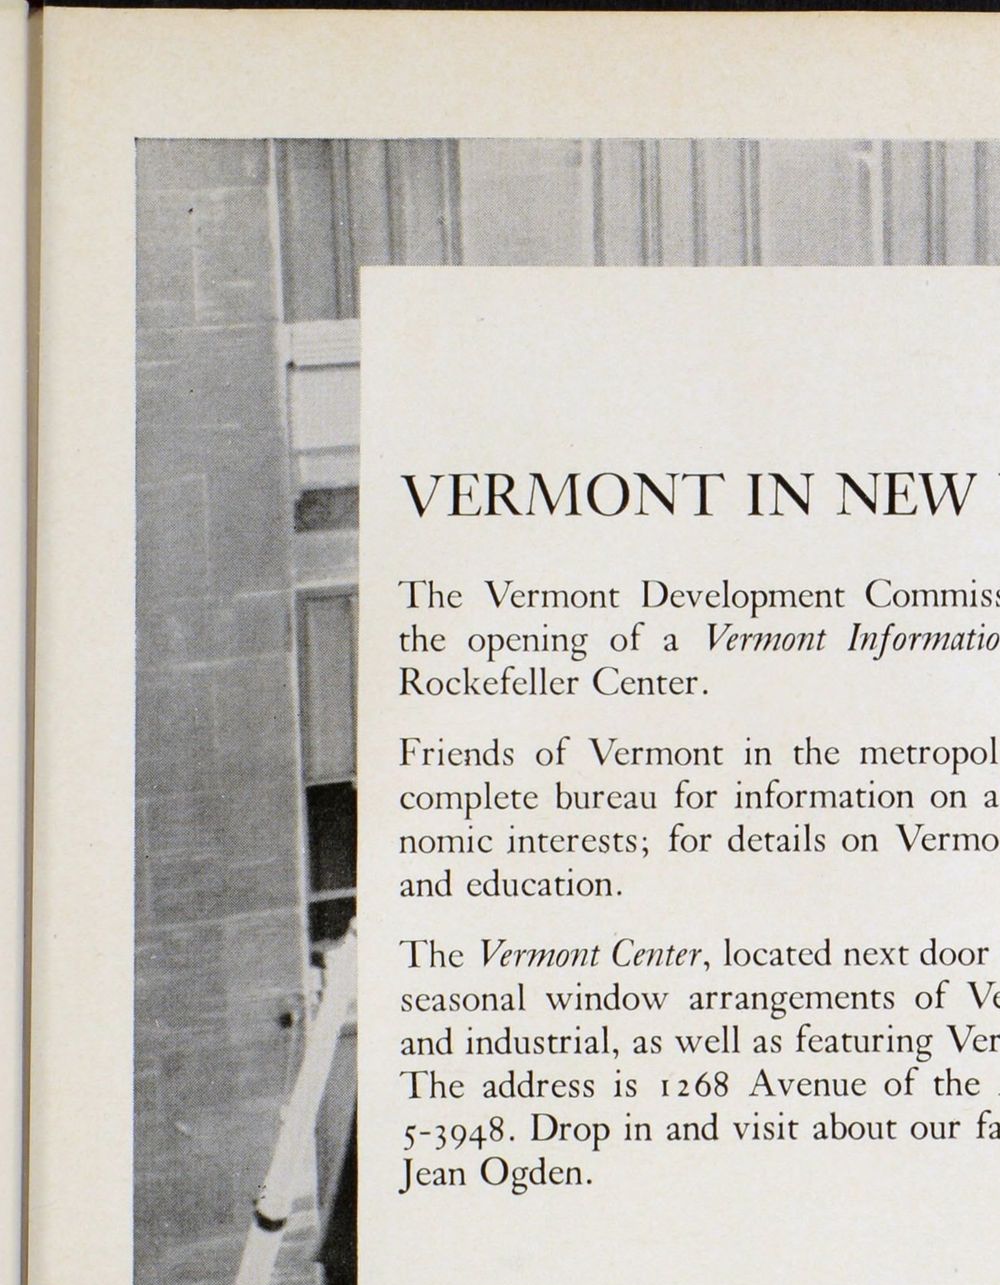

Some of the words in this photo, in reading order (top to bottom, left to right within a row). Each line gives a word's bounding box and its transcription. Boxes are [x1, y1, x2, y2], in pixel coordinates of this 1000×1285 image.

[400, 472, 726, 518] VERMONT
[747, 472, 815, 516] IN
[835, 471, 978, 517] NEW
[398, 579, 462, 609] The
[484, 580, 620, 609] Vermont
[642, 579, 845, 619] Development
[399, 623, 446, 652] the
[468, 623, 589, 663] opening
[610, 621, 646, 652] of
[663, 633, 679, 652] a
[708, 623, 827, 652] Vermont
[399, 665, 579, 696] Rockefeller
[592, 666, 708, 696] Center.
[399, 737, 514, 767] Friends
[535, 735, 571, 766] of
[589, 737, 724, 766] Vermont
[744, 736, 772, 766] in
[793, 736, 840, 765] the
[399, 781, 538, 820] complete
[555, 781, 657, 810] bureau
[675, 779, 718, 810] for
[735, 778, 914, 809] information
[930, 790, 967, 809] on
[399, 825, 493, 854] nomic
[507, 832, 649, 858] interests;
[669, 822, 712, 853] for
[727, 823, 826, 853] details
[841, 833, 878, 853] on
[400, 868, 452, 898] and
[466, 867, 622, 897] education.
[399, 939, 464, 968] The
[481, 938, 601, 968] Vermont
[612, 938, 710, 971] Center,
[724, 937, 832, 967] located
[844, 945, 909, 966] next
[920, 937, 990, 966] door
[401, 982, 526, 1012] seasonal
[545, 982, 669, 1011] window
[689, 989, 895, 1020] arrangements
[914, 979, 950, 1010] of
[400, 1026, 453, 1056] and
[466, 1025, 619, 1060] industrial,
[633, 1035, 662, 1055] as
[675, 1024, 740, 1054] well
[753, 1035, 782, 1054] as
[796, 1022, 934, 1063] featuring
[399, 1070, 465, 1099] The
[482, 1069, 595, 1099] address
[614, 1069, 637, 1098] is
[661, 1071, 729, 1098] 1268
[748, 1068, 867, 1097] Avenue
[884, 1066, 920, 1097] of
[933, 1067, 980, 1097] the
[403, 1115, 515, 1151] 5-3948.
[531, 1113, 611, 1152] Drop
[624, 1112, 652, 1141] in
[666, 1112, 719, 1141] and
[733, 1111, 799, 1141] visit
[813, 1111, 897, 1141] about
[910, 1120, 961, 1140] our
[398, 1158, 466, 1195] Jean
[480, 1156, 592, 1196] Ogden.
